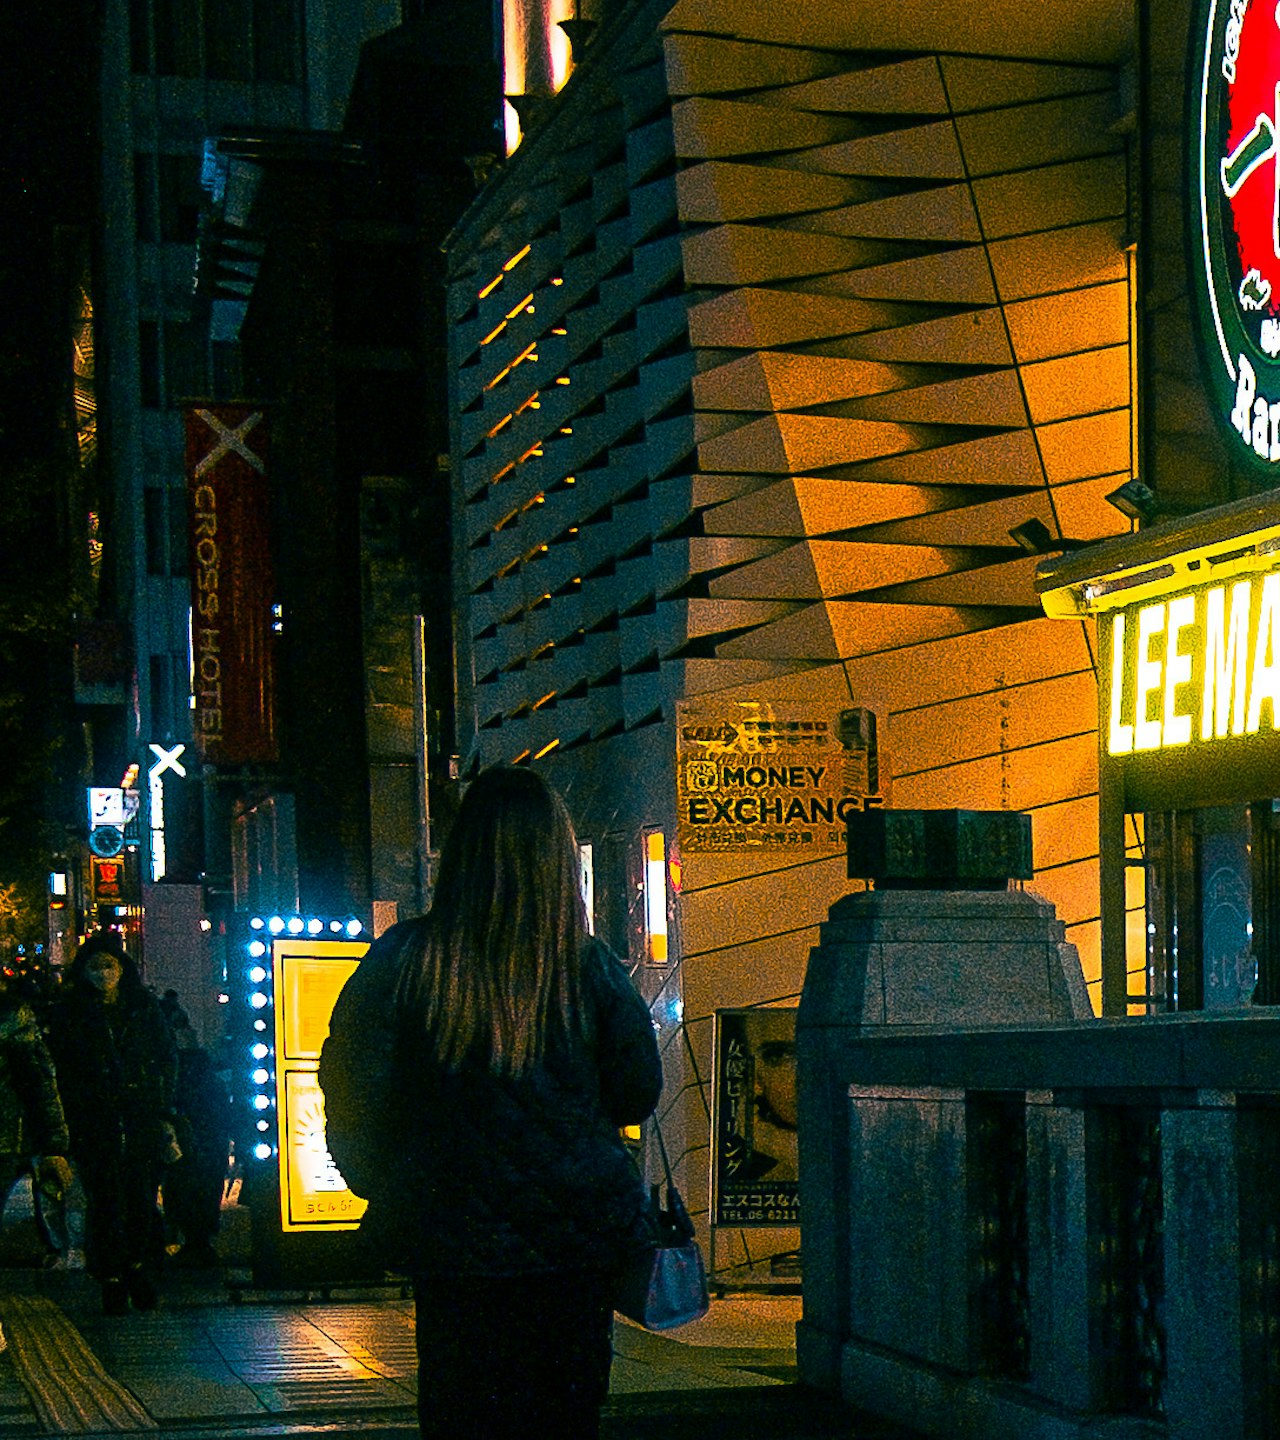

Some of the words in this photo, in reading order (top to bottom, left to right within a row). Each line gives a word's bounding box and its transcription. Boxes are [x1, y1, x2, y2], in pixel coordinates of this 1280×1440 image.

[194, 483, 220, 622] CROSS
[199, 627, 225, 757] HOTEL
[1108, 601, 1193, 755] LEE
[722, 766, 826, 788] MONEY
